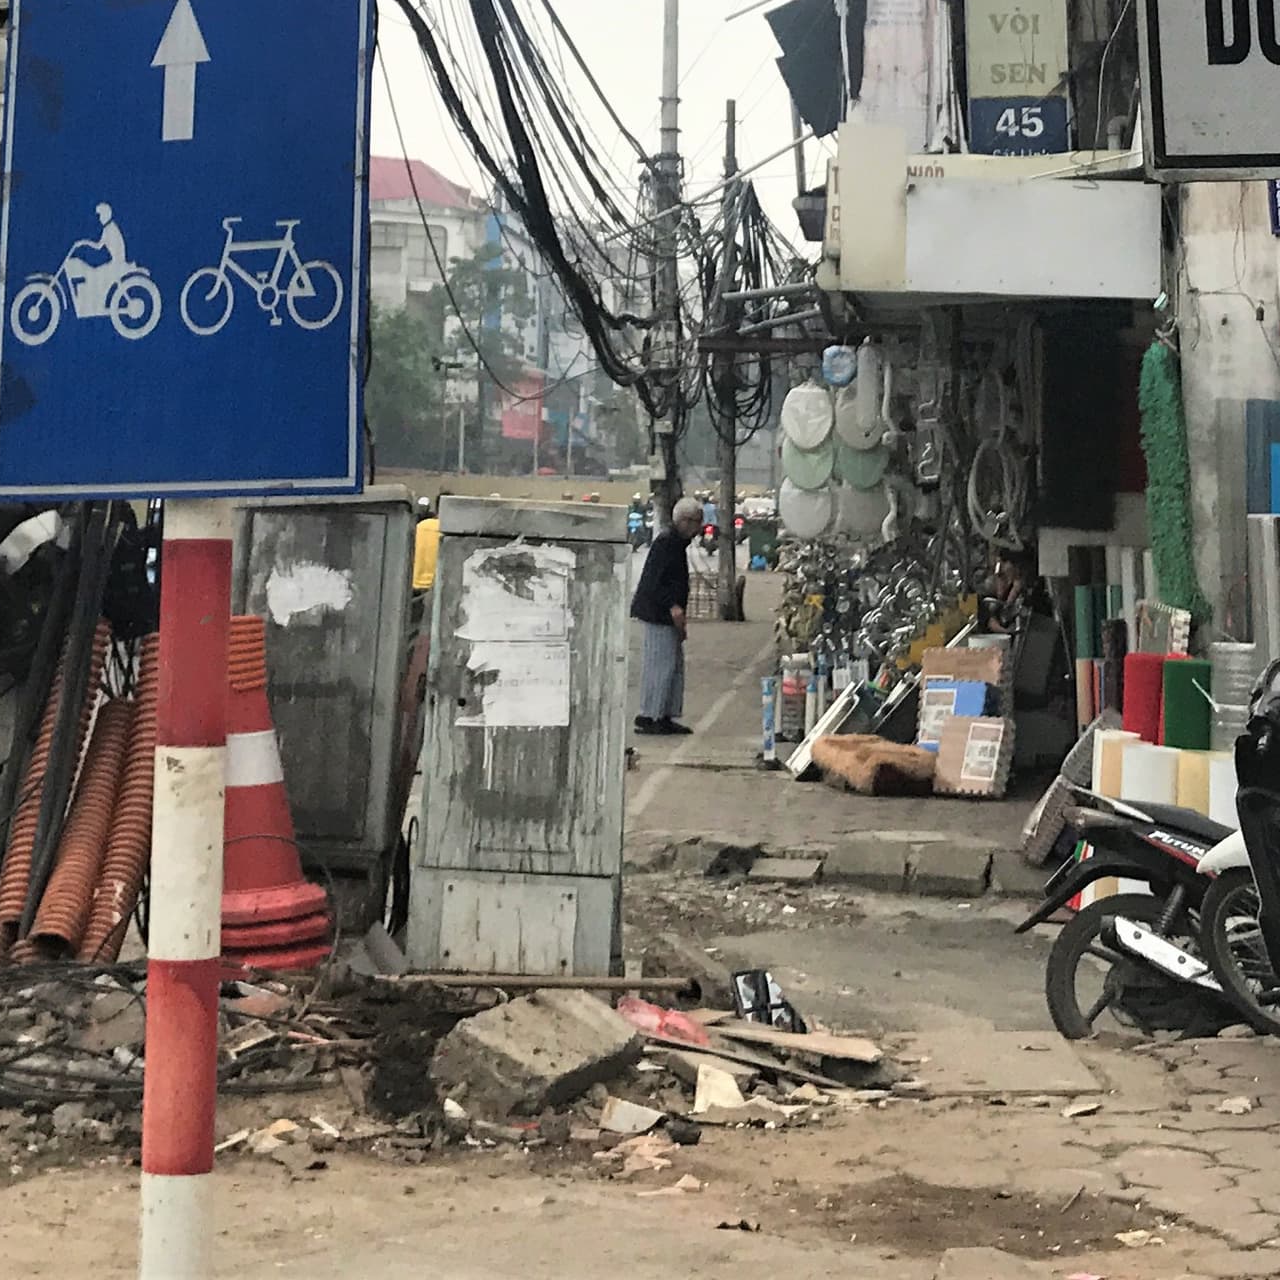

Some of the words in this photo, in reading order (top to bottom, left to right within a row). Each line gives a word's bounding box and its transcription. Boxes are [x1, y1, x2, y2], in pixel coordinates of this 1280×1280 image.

[990, 62, 1046, 85] SEN
[995, 107, 1044, 138] 45
[1148, 830, 1207, 858] FUTUR
